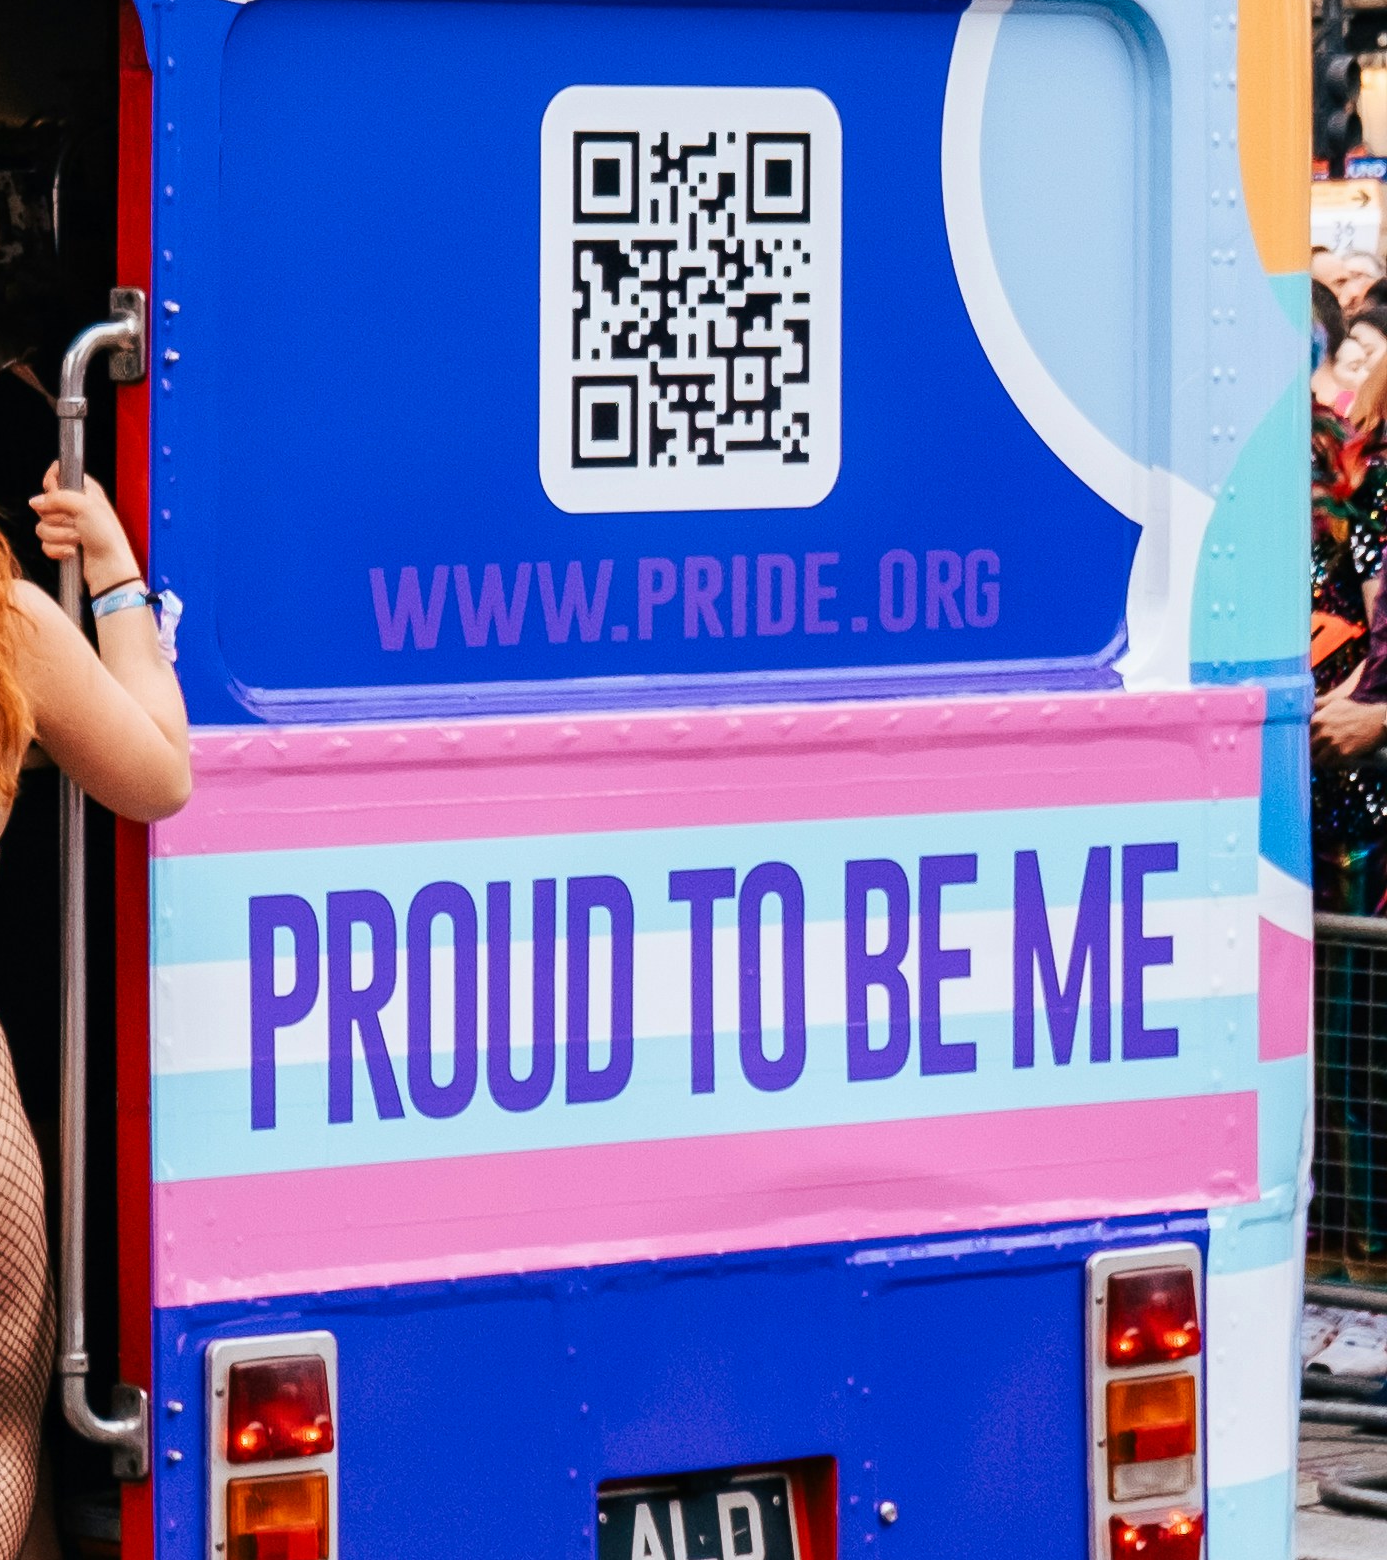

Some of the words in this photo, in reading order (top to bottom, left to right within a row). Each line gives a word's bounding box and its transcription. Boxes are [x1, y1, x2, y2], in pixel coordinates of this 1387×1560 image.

[368, 547, 1002, 652] WWW.PRIDE.ORG
[248, 871, 635, 1131] PROUD
[668, 860, 808, 1095] TO
[843, 852, 978, 1087] BE
[1012, 840, 1180, 1070] ME
